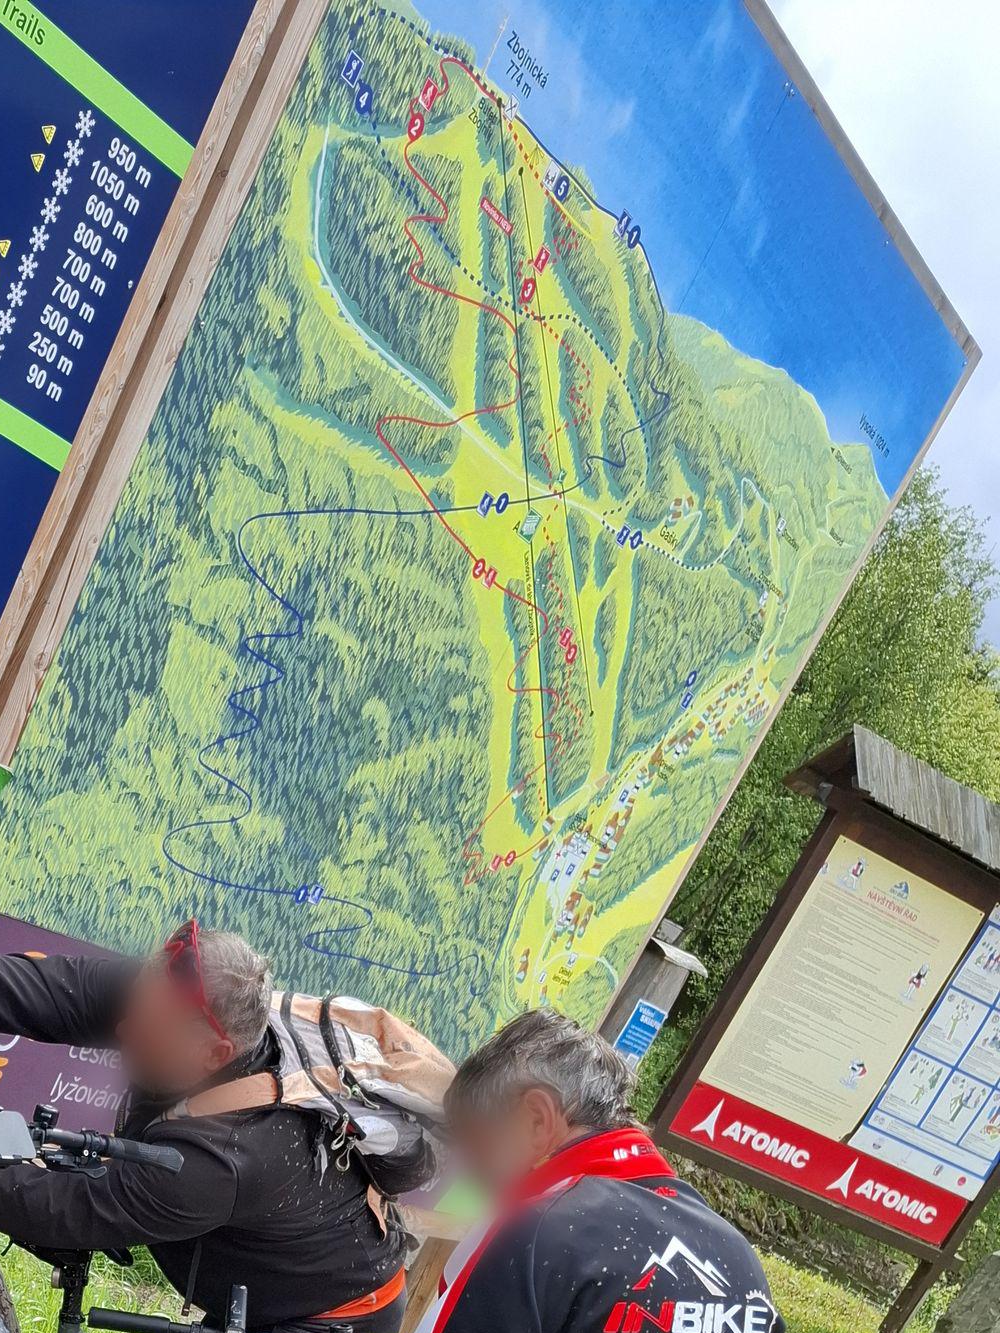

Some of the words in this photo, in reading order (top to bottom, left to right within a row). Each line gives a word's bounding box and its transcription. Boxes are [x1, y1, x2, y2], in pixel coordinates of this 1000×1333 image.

[505, 30, 550, 89] Zbojnická
[507, 61, 523, 88] 774
[522, 85, 532, 99] m
[359, 92, 368, 107] 4
[411, 118, 421, 134] 2
[108, 137, 137, 172] 950
[137, 168, 152, 188] m
[89, 160, 125, 202] 1050
[125, 195, 140, 216] m
[558, 180, 567, 196] 5
[85, 194, 114, 229] 600
[114, 224, 129, 243] m
[73, 222, 103, 257] 800
[103, 251, 118, 271] m
[63, 249, 92, 284] 700
[92, 278, 107, 297] m
[524, 284, 532, 297] 3
[52, 276, 80, 311] 700
[80, 304, 96, 324] m
[39, 304, 69, 339] 500
[69, 332, 84, 351] m
[28, 331, 58, 365] 250
[58, 358, 73, 377] m
[26, 364, 47, 391] 90
[47, 383, 62, 402] m
[475, 561, 484, 576] 2
[721, 1120, 811, 1170] ATOMIC
[854, 1179, 938, 1225] ATOMIC
